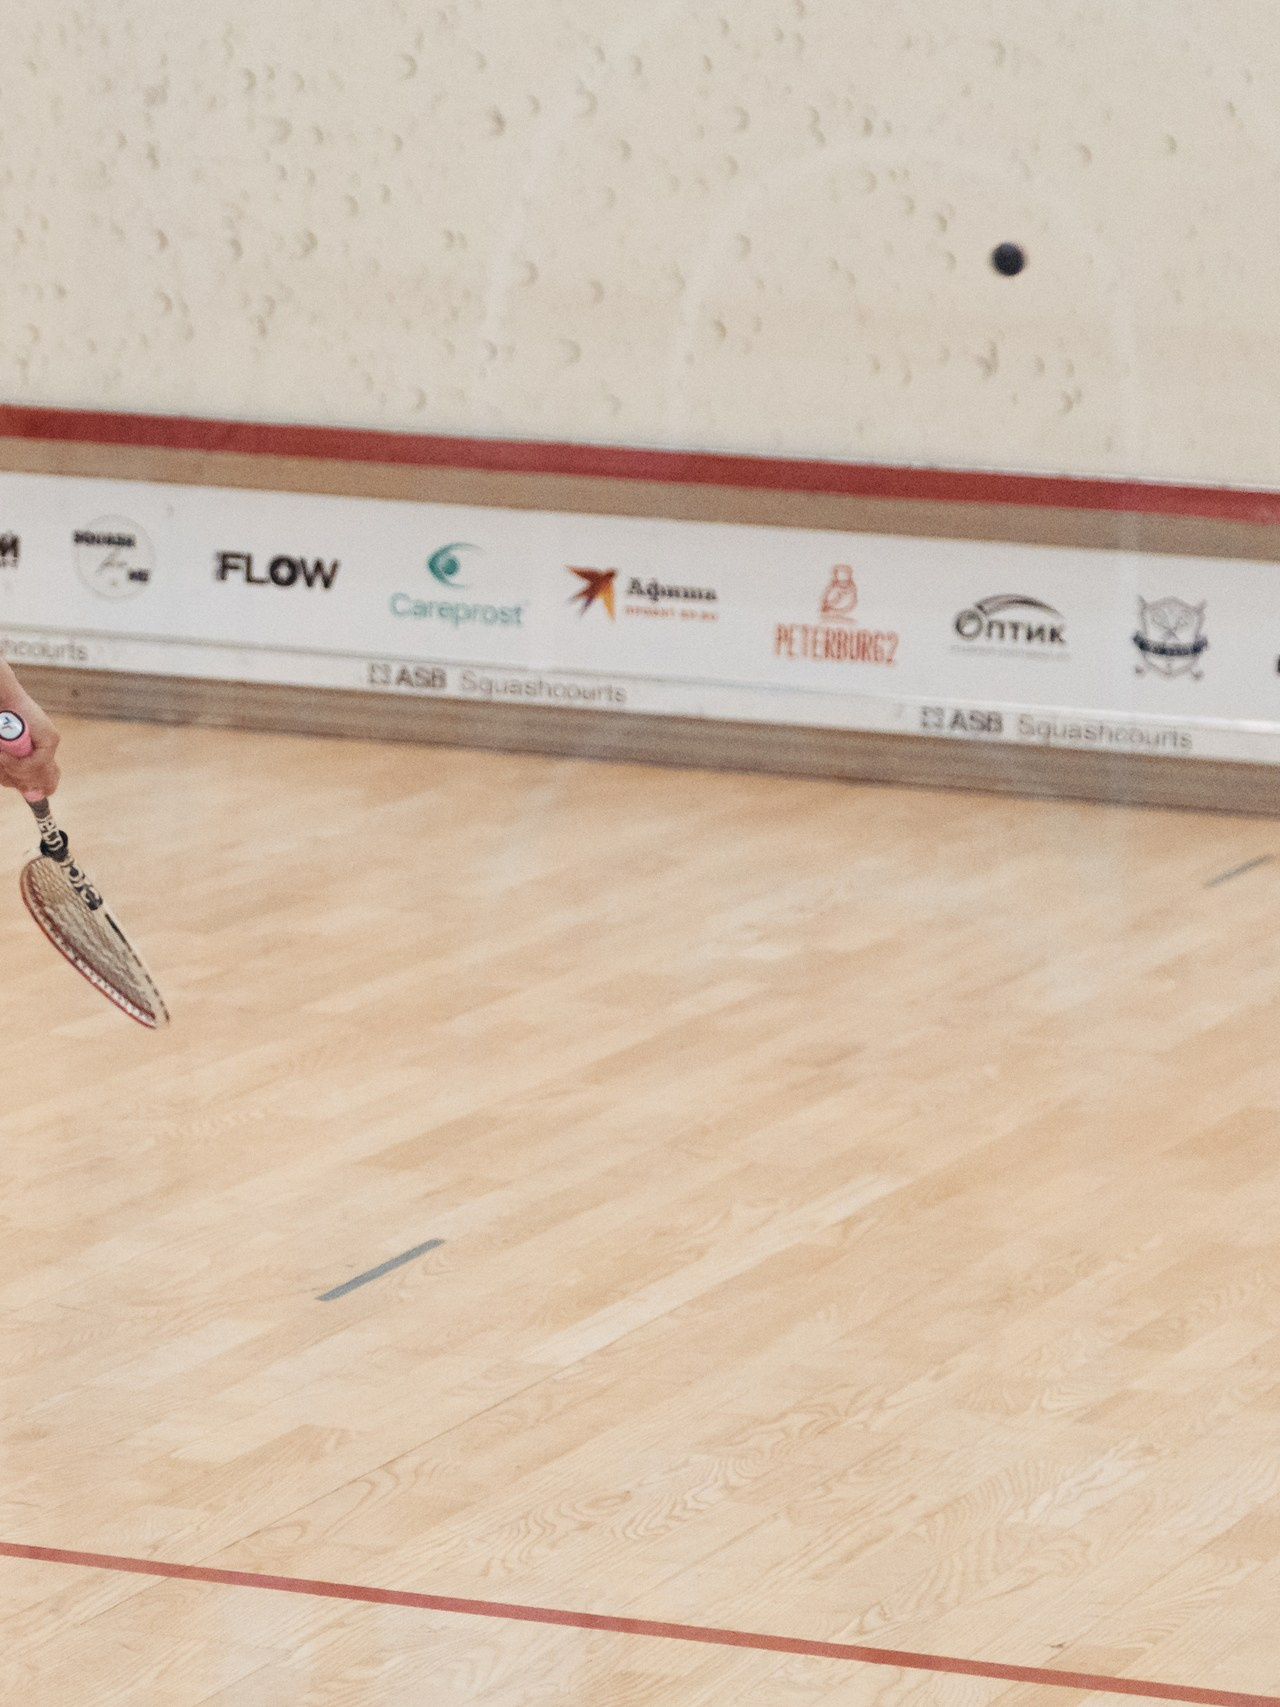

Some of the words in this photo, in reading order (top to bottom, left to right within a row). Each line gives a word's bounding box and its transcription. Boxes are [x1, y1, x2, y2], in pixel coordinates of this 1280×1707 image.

[215, 551, 340, 589] FLOW
[626, 576, 718, 603] Афиша
[389, 592, 523, 626] Careprost
[394, 665, 448, 689] ASB
[460, 669, 629, 703] Squashcourts
[949, 709, 1004, 733] ASB
[1019, 712, 1194, 750] Squashcourts
